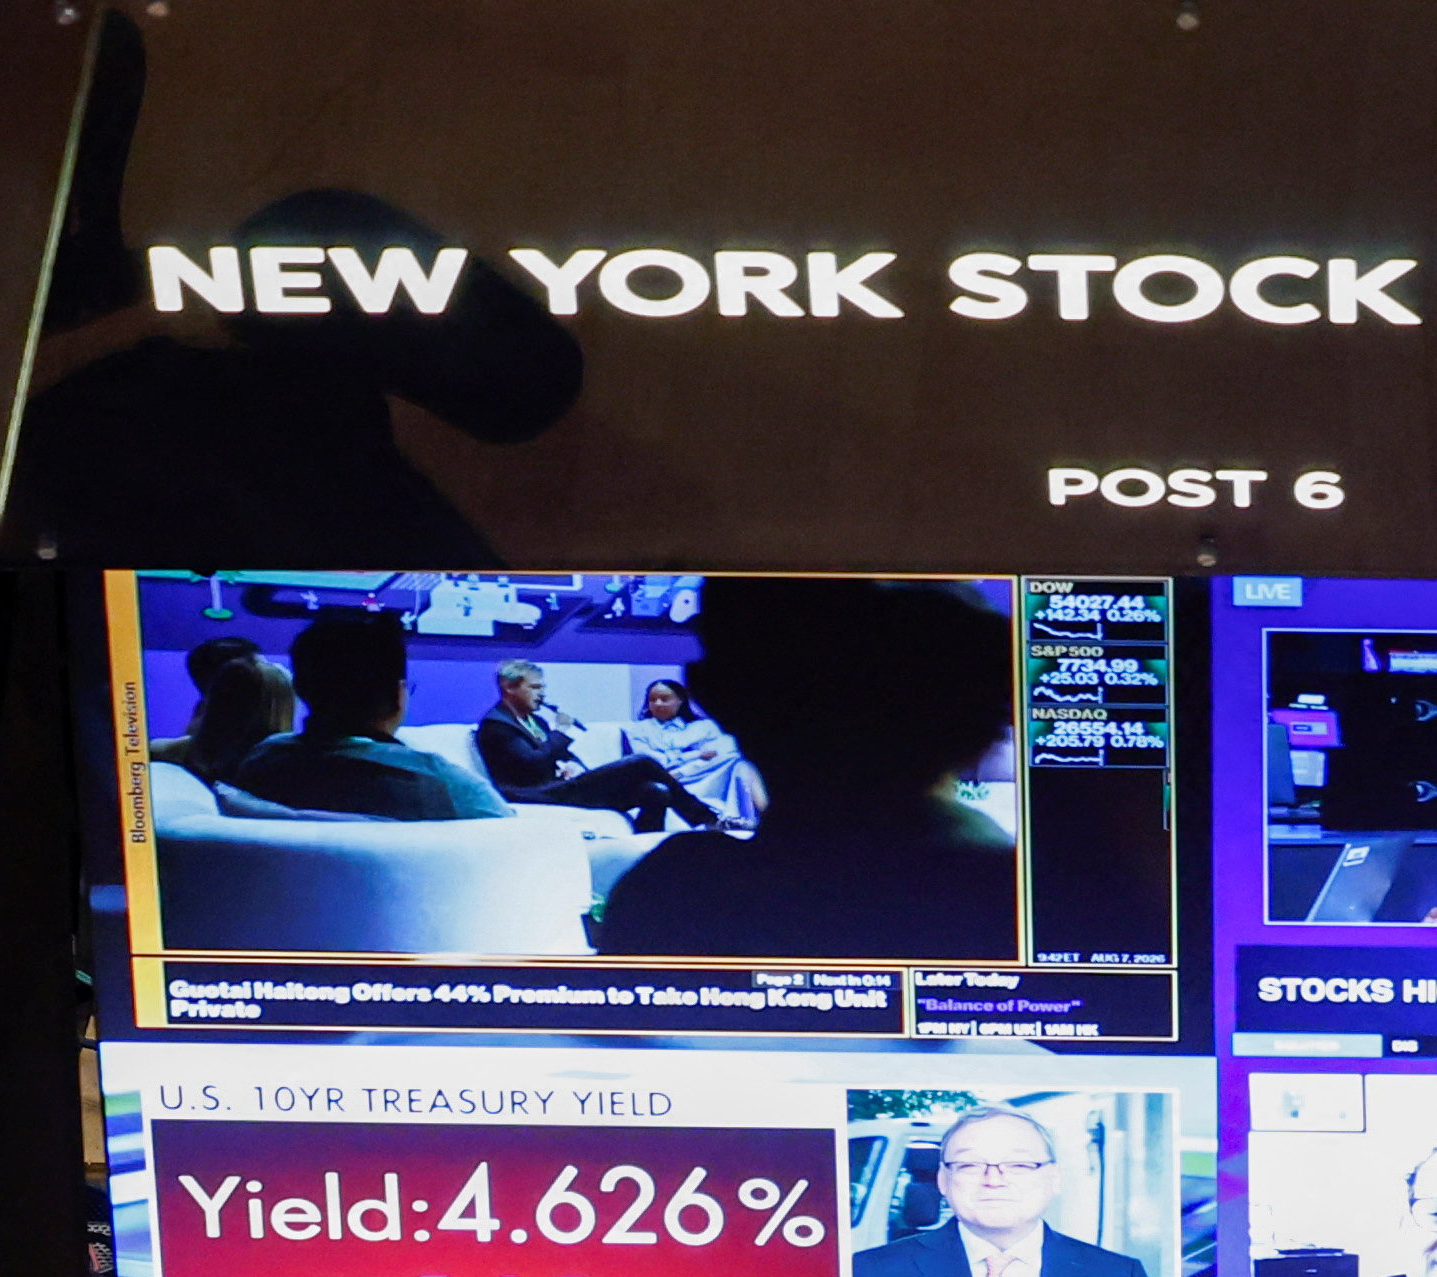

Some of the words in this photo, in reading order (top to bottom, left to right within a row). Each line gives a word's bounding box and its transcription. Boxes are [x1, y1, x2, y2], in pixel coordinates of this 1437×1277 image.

[148, 245, 468, 314] NEW
[508, 248, 905, 319] YORK
[948, 252, 1422, 326] STOCK
[1048, 467, 1268, 508] POST
[1293, 470, 1345, 510] 6
[1030, 582, 1073, 593] DOW
[1245, 582, 1291, 602] LIVE
[1031, 646, 1069, 657] S&P
[123, 682, 139, 756] Television
[1032, 708, 1107, 720] NASDAQ
[129, 761, 146, 843] Bloomberg
[353, 983, 432, 1002] Offers
[494, 985, 605, 1005] Premium
[608, 987, 631, 1005] to
[635, 986, 697, 1006] Take
[700, 986, 764, 1009] Hong
[767, 987, 832, 1009] Kong
[835, 988, 886, 1007] Unit
[1258, 977, 1394, 1003] STOCKS
[171, 1001, 261, 1019] Private
[159, 1085, 233, 1112] U.S.
[253, 1088, 347, 1114] 10YR
[361, 1088, 555, 1115] TREASURY
[569, 1091, 673, 1116] YIELD
